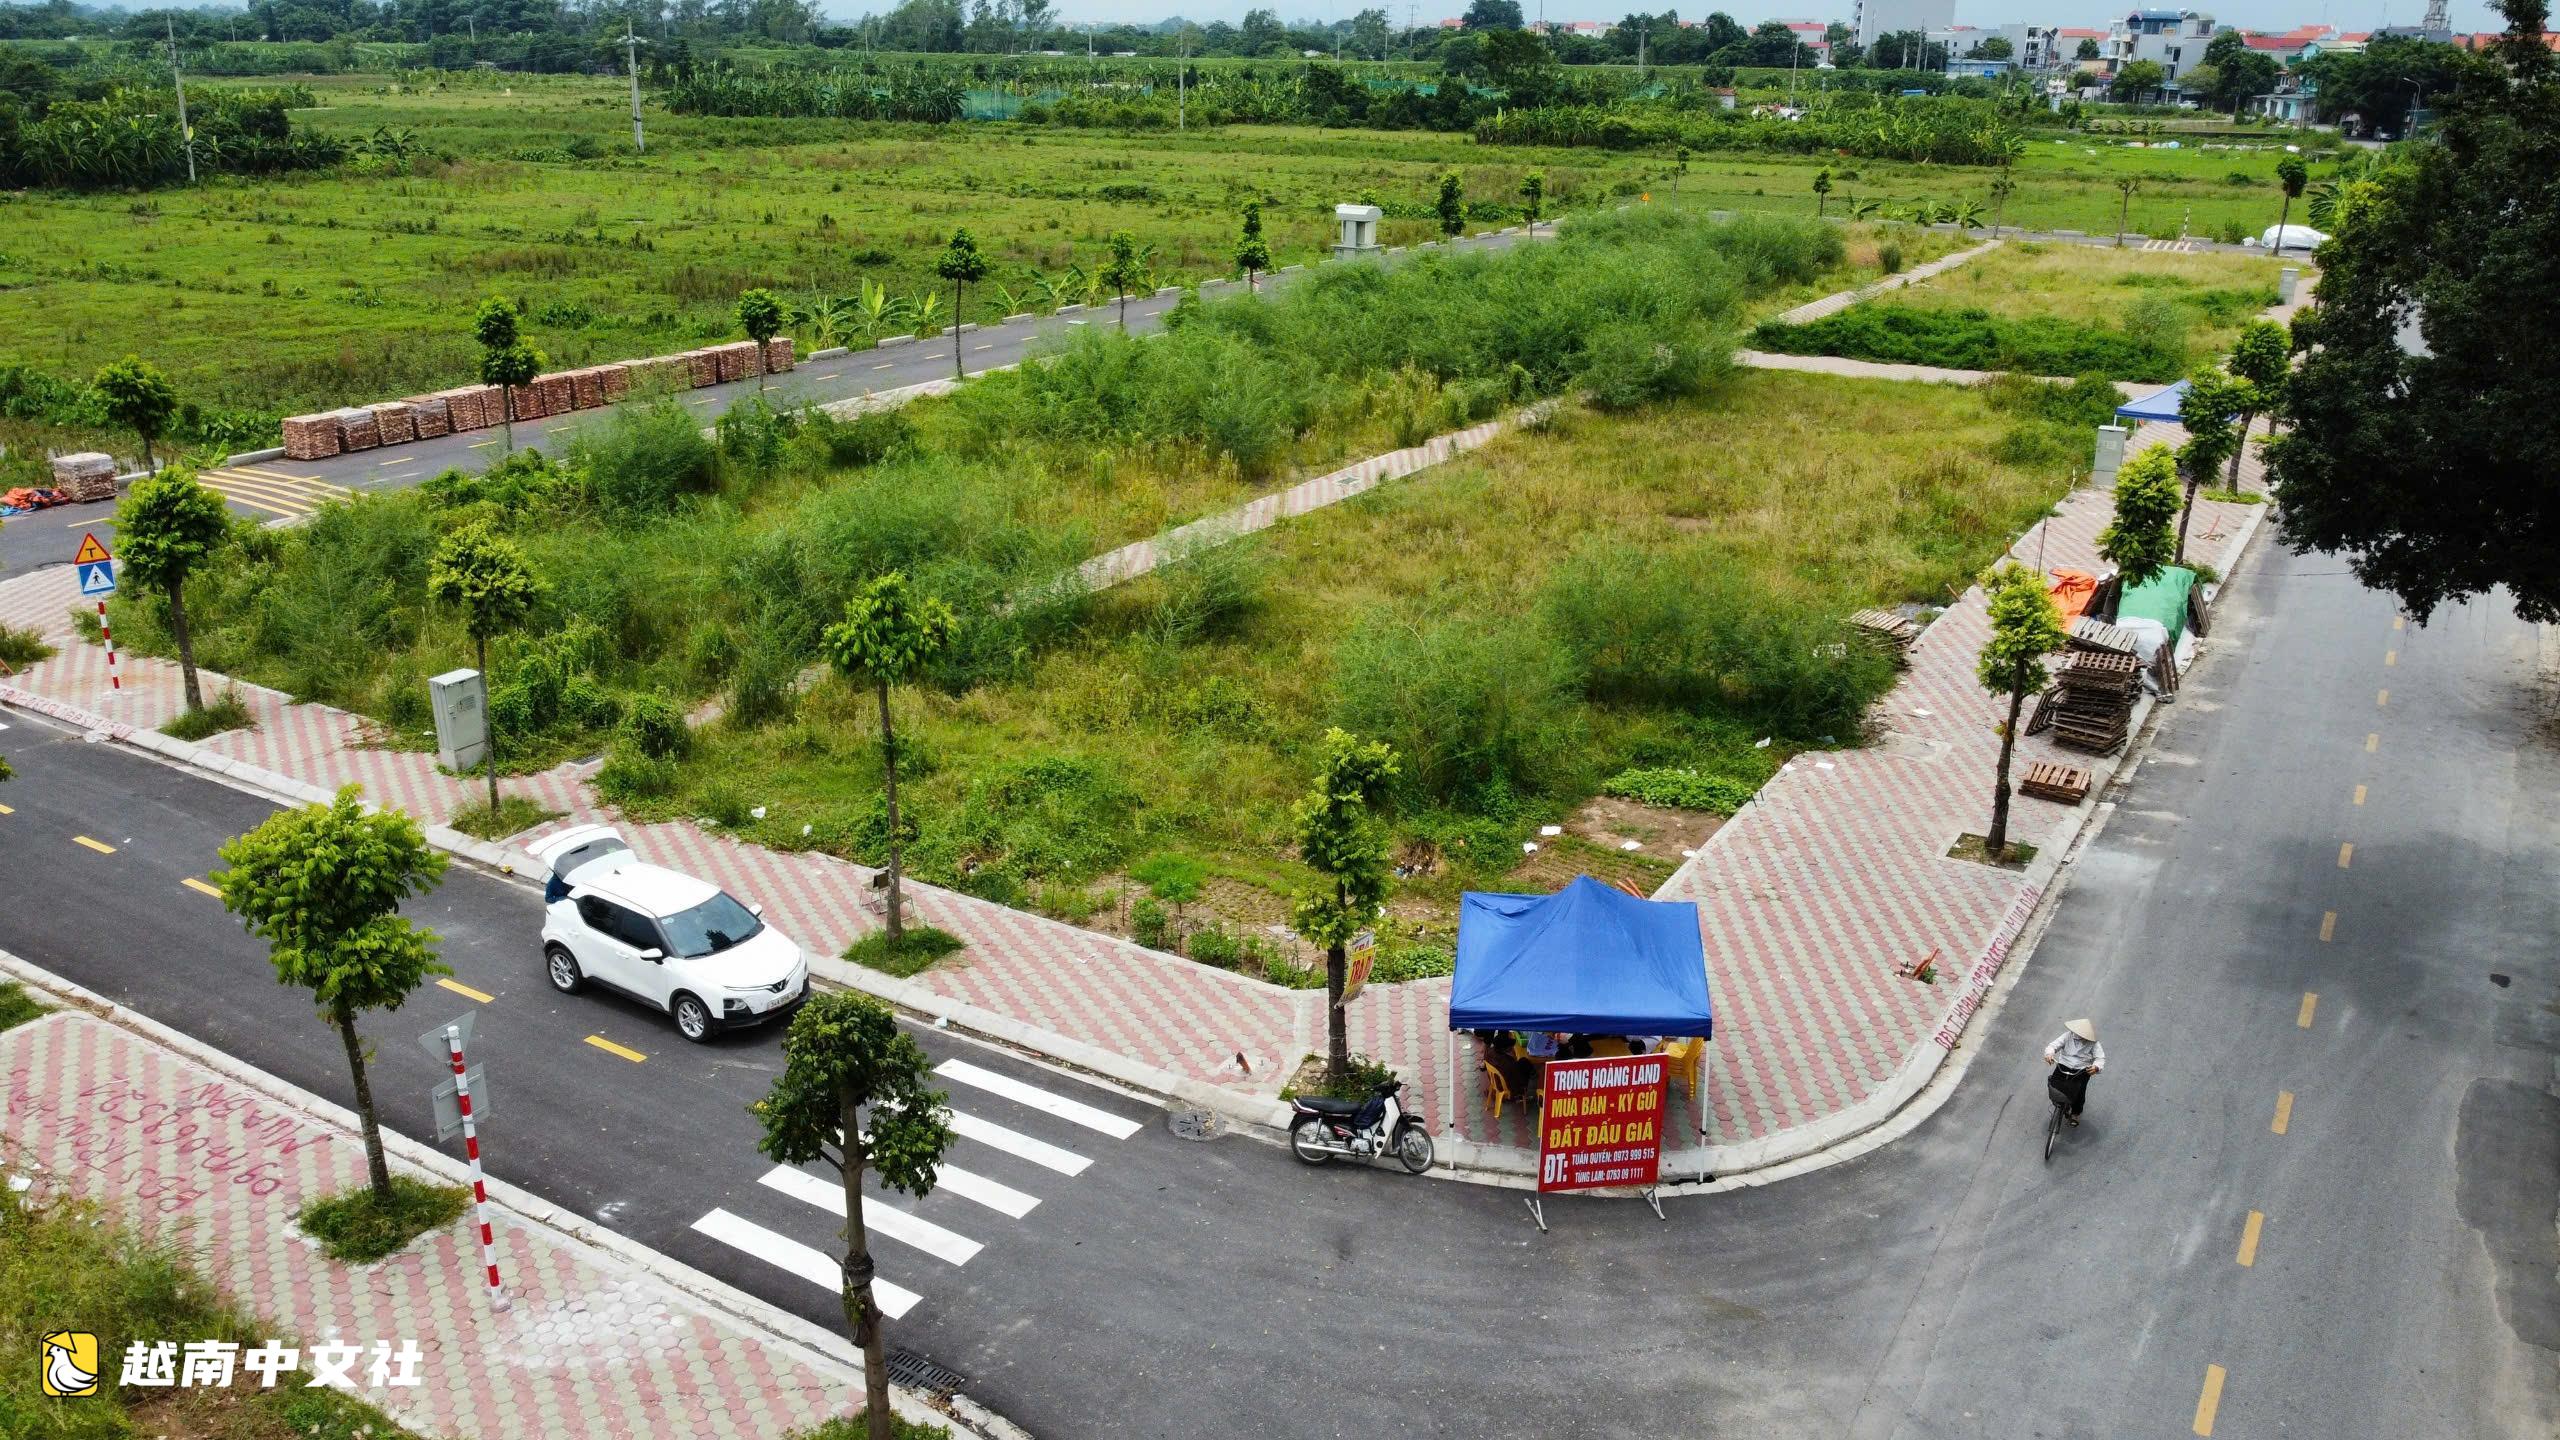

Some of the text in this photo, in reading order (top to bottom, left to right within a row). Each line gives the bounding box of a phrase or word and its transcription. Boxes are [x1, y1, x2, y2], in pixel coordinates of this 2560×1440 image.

[1553, 1069, 1589, 1095] TRỌNG
[1631, 1063, 1660, 1085] LAND
[1551, 1097, 1578, 1118] MUA
[1581, 1092, 1607, 1116] BÁN
[1618, 1089, 1634, 1113] KÝ
[1549, 1117, 1654, 1149] ĐẤT ĐẤU GIÁ
[1544, 1153, 1569, 1184] ĐT:
[1613, 1150, 1629, 1162] 0973
[1642, 1147, 1655, 1160] 515
[1630, 1167, 1644, 1179] 1111
